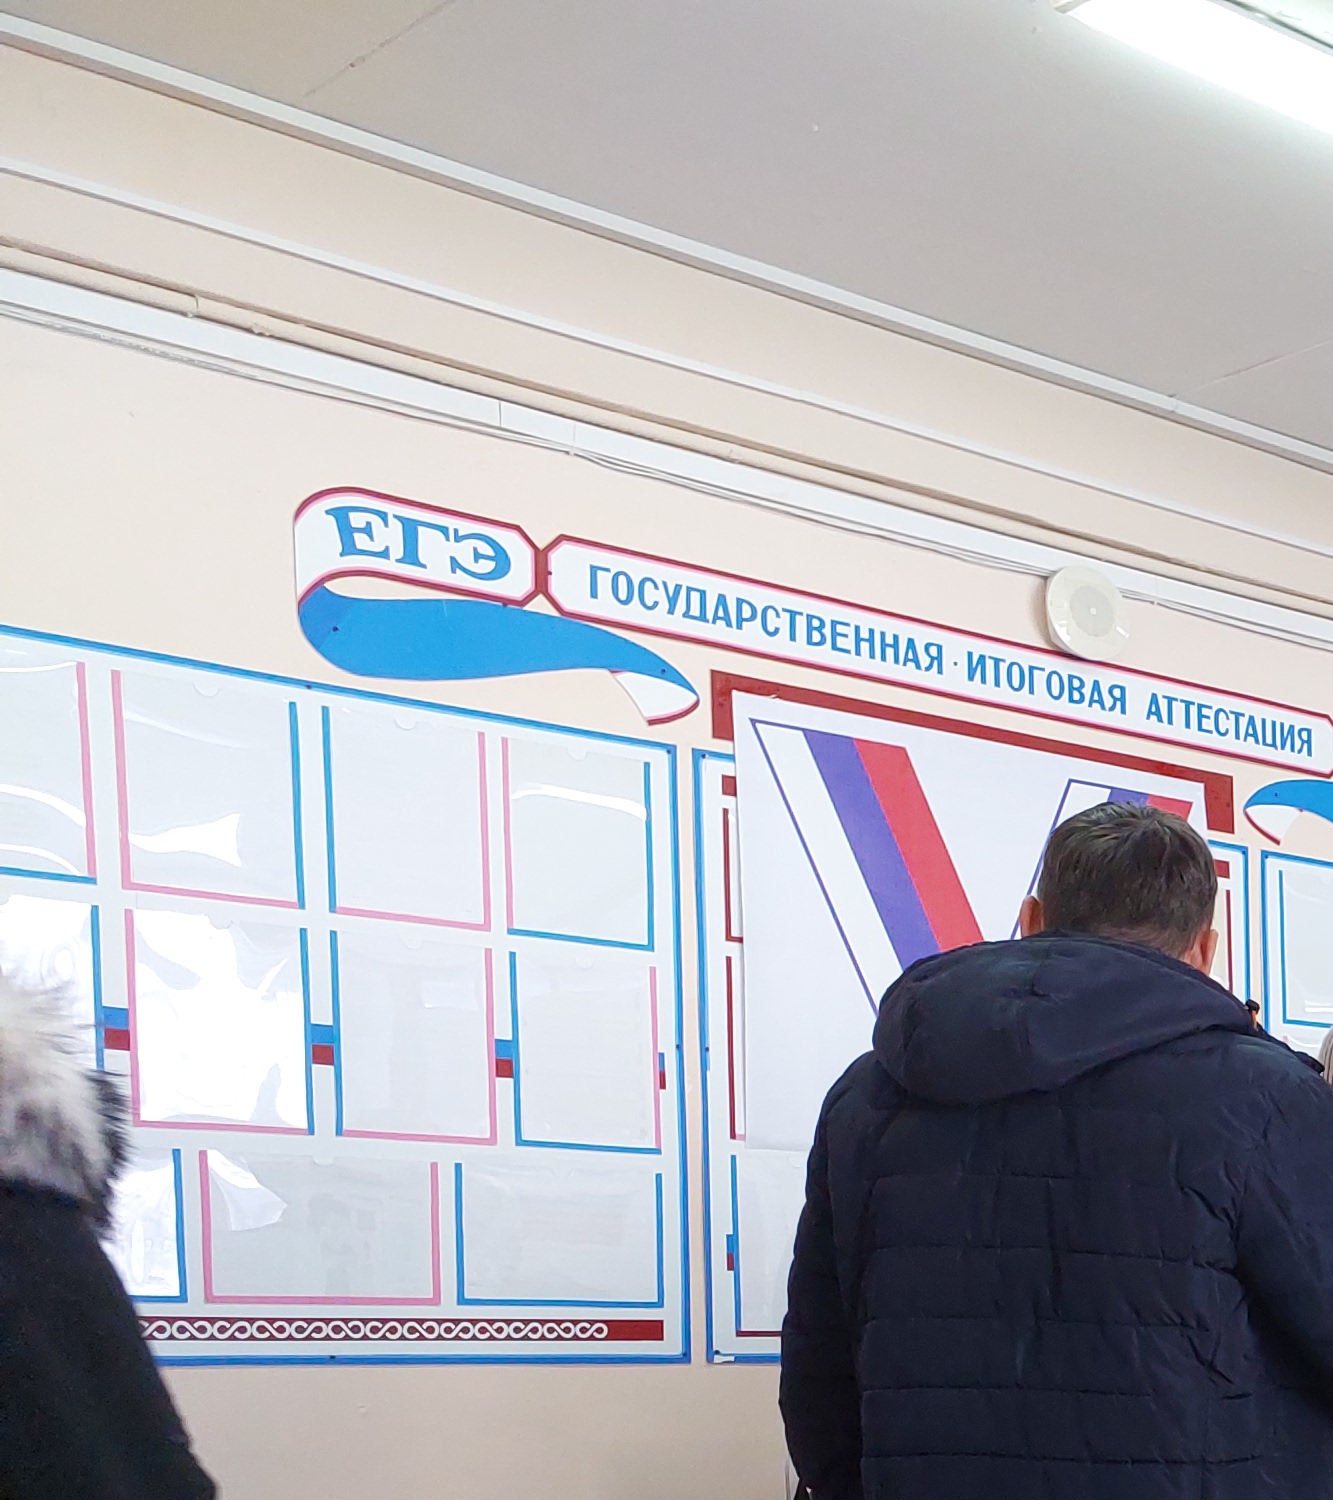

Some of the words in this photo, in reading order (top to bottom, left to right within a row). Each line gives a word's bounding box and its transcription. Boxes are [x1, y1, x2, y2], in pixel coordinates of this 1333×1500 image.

[325, 505, 512, 582] ЕГЭ
[588, 563, 943, 675] ГОСУДАРСТВЕННАЯ
[966, 650, 1128, 715] ИТОГОВАЯ
[1146, 692, 1314, 757] АТТЕСТАЦИЯ
